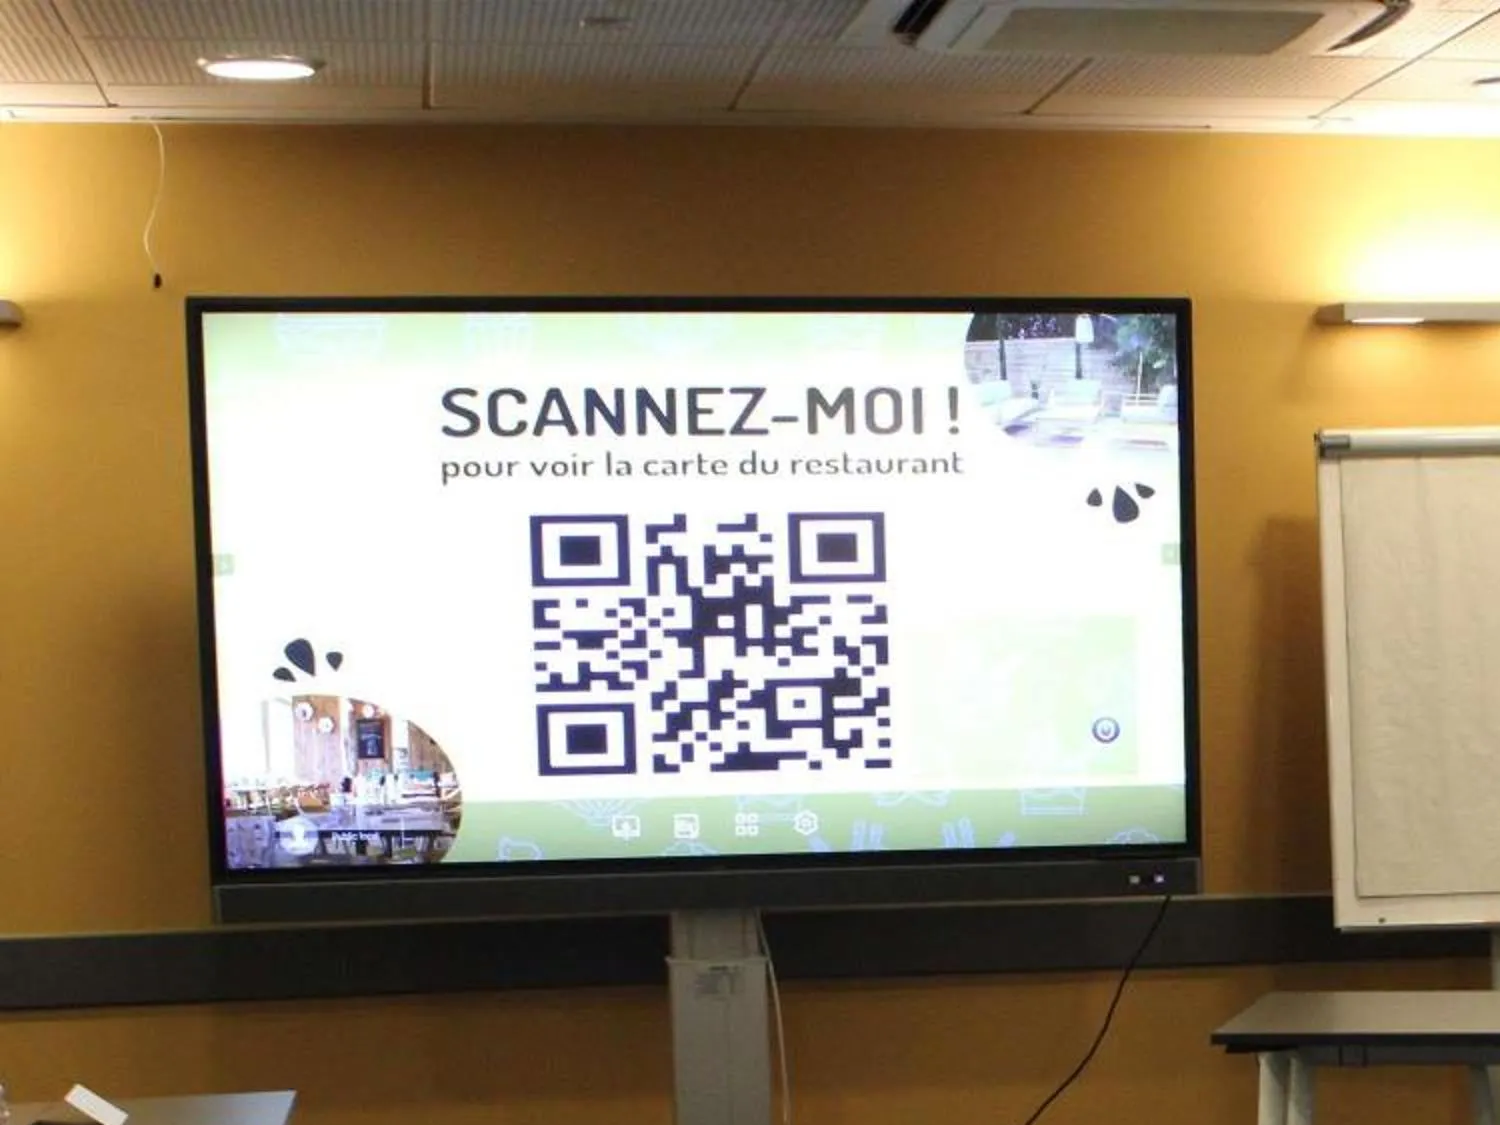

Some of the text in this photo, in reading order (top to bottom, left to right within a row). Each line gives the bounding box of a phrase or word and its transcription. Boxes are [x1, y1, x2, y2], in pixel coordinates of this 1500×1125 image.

[441, 449, 964, 487] pour voir la carte du restaurant
